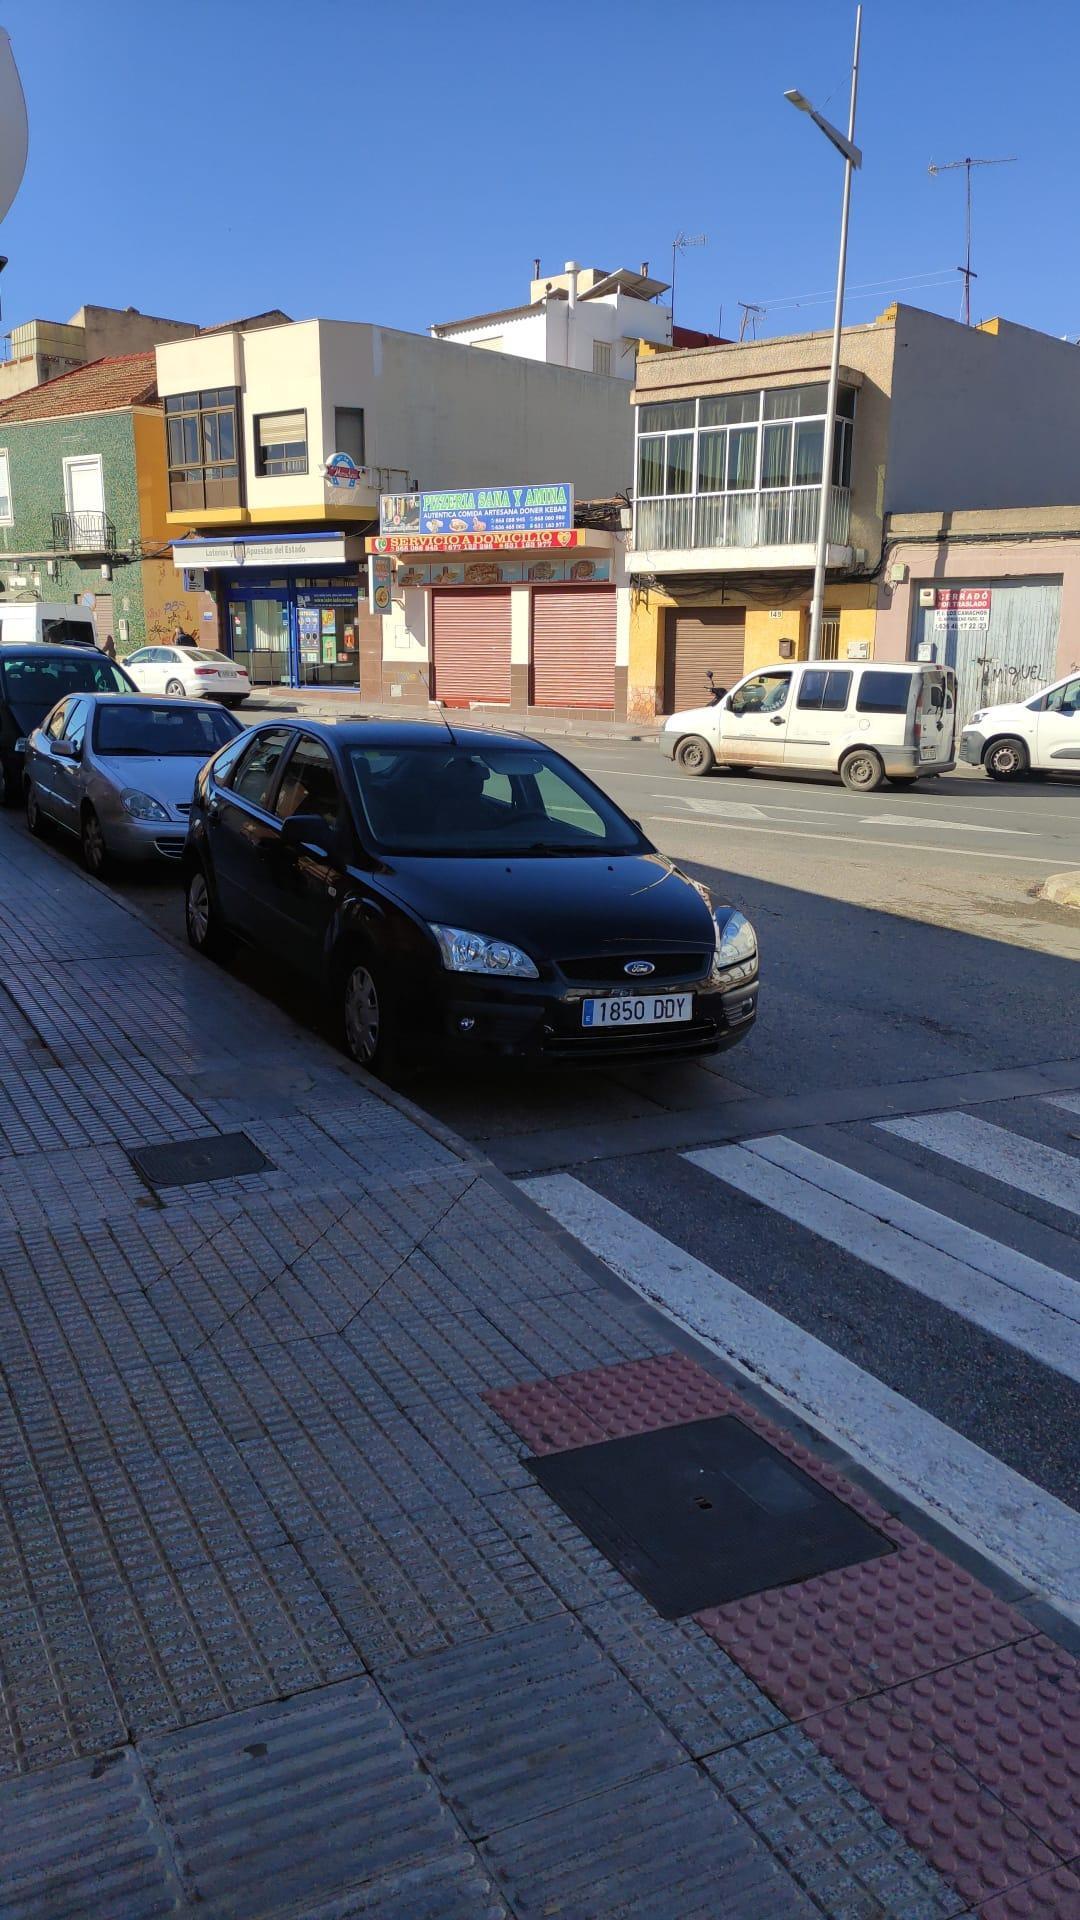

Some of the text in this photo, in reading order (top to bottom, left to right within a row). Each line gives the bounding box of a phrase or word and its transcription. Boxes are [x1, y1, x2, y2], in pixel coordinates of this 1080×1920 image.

[478, 490, 511, 508] SANA
[512, 489, 523, 507] Y
[525, 486, 568, 506] AMINA
[423, 505, 567, 519] AUTENTICA COMIDA ARTESANA DONER KEBAB
[390, 532, 552, 546] SERVICIO A DOMICILIO
[246, 547, 272, 556] Apuestas
[274, 546, 284, 554] del
[284, 544, 306, 553] Estado
[632, 964, 648, 973] Ford
[600, 1000, 645, 1022] 1850
[654, 998, 686, 1020] DDY
